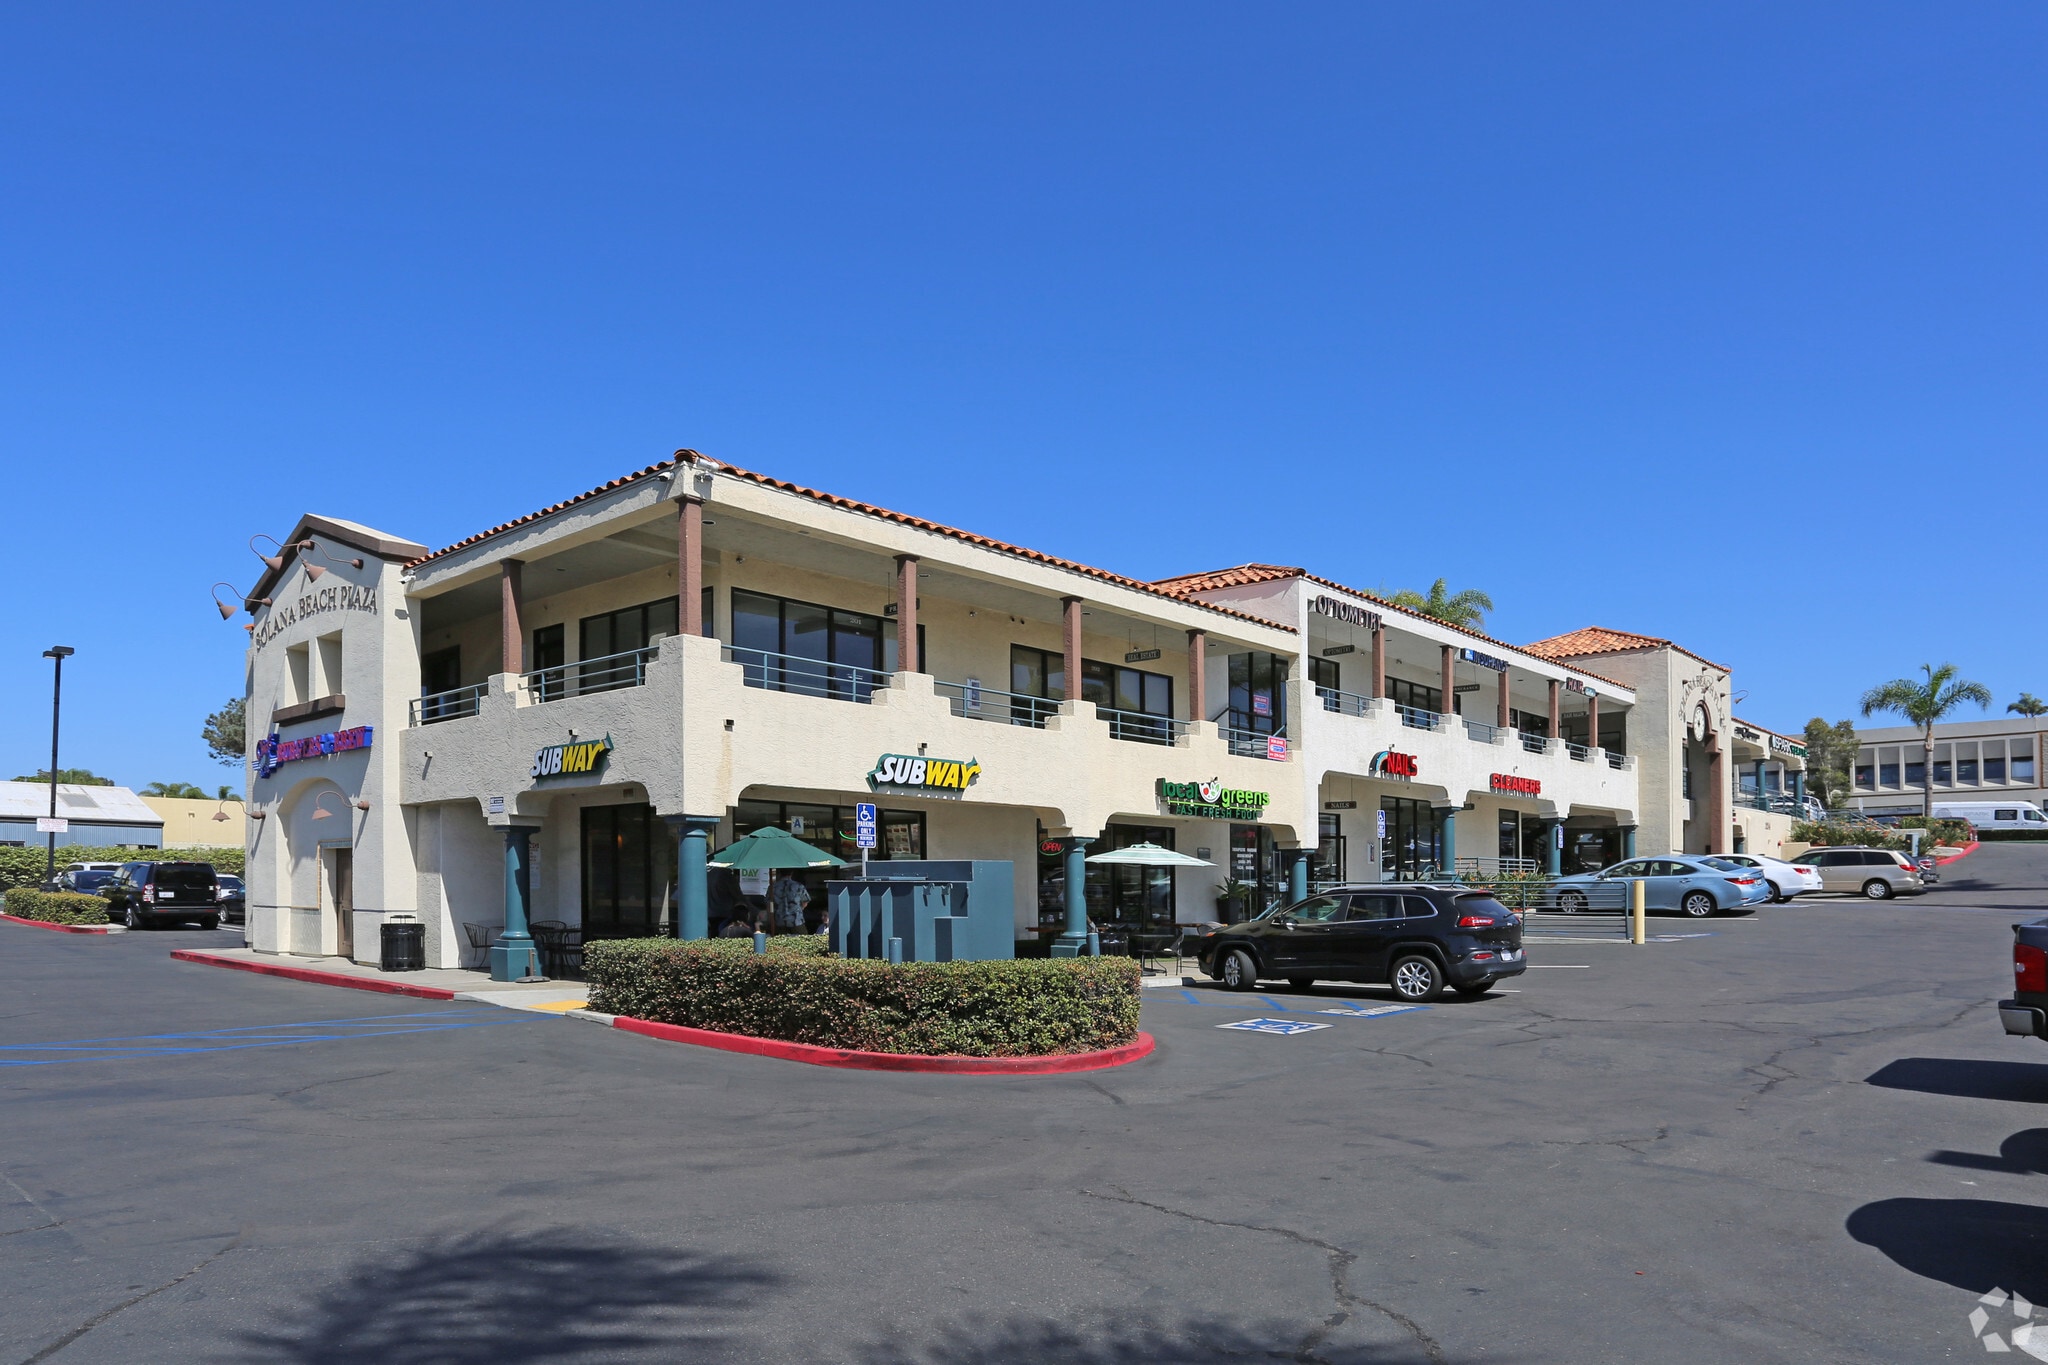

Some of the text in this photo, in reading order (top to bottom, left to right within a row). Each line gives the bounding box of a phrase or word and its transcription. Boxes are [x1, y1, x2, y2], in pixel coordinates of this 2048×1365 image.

[256, 586, 378, 650] SOLANA BEACH PLAZA
[1316, 594, 1382, 631] OPTOMETRY
[530, 741, 606, 777] SUBWAY
[1387, 752, 1417, 776] NAILS
[875, 756, 982, 789] SUBWAY
[1491, 773, 1541, 794] CLEANERS
[1161, 778, 1270, 808] local greens
[794, 818, 801, 828] A
[1176, 805, 1258, 821] FAST FRESH FOOD
[1041, 841, 1062, 852] OPEN
[741, 869, 759, 877] DAY
